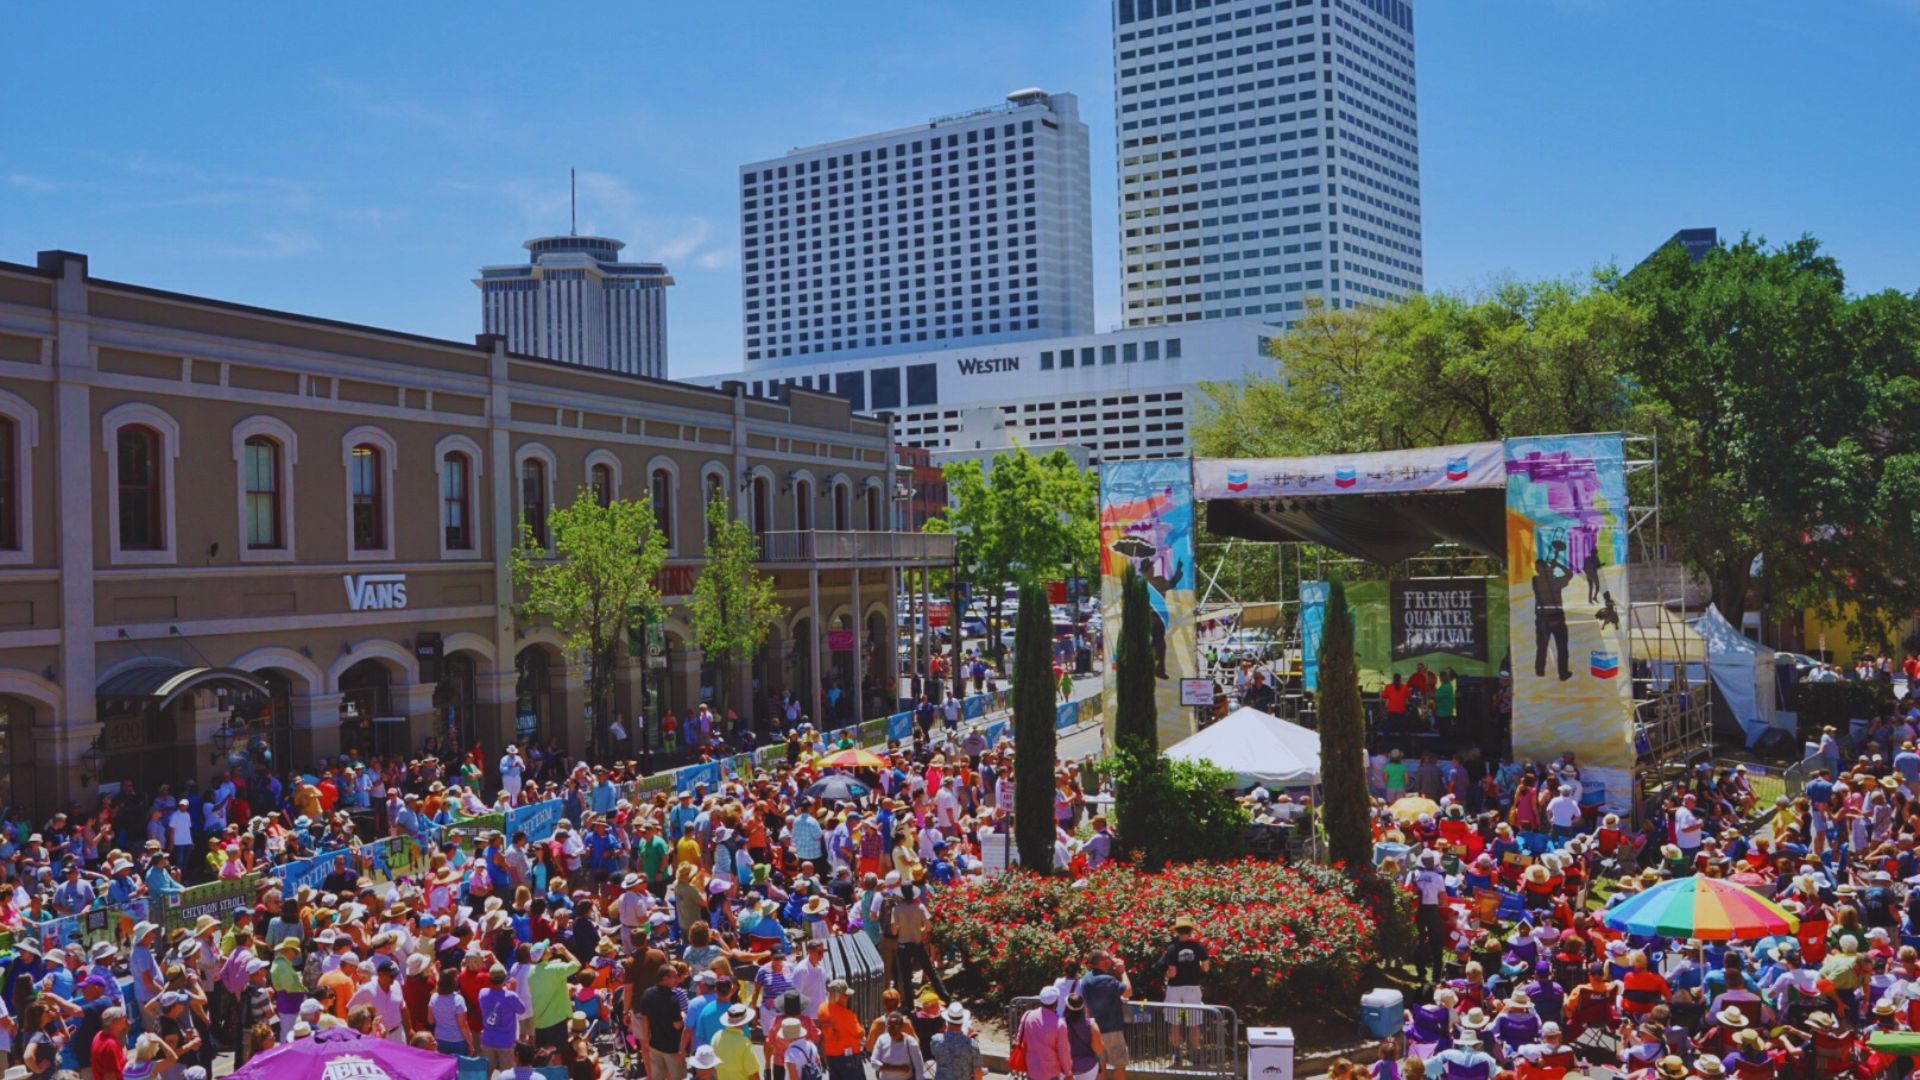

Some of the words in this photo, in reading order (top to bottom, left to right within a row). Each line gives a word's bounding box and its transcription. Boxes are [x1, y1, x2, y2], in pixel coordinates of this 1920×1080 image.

[957, 357, 1019, 375] WESTIN
[343, 574, 407, 610] VANS
[1403, 590, 1472, 608] FRENCH
[1404, 609, 1474, 628] QUARTER
[1405, 628, 1474, 645] FESTIVAL
[182, 902, 218, 919] CHEVRON
[219, 895, 246, 912] STROLL
